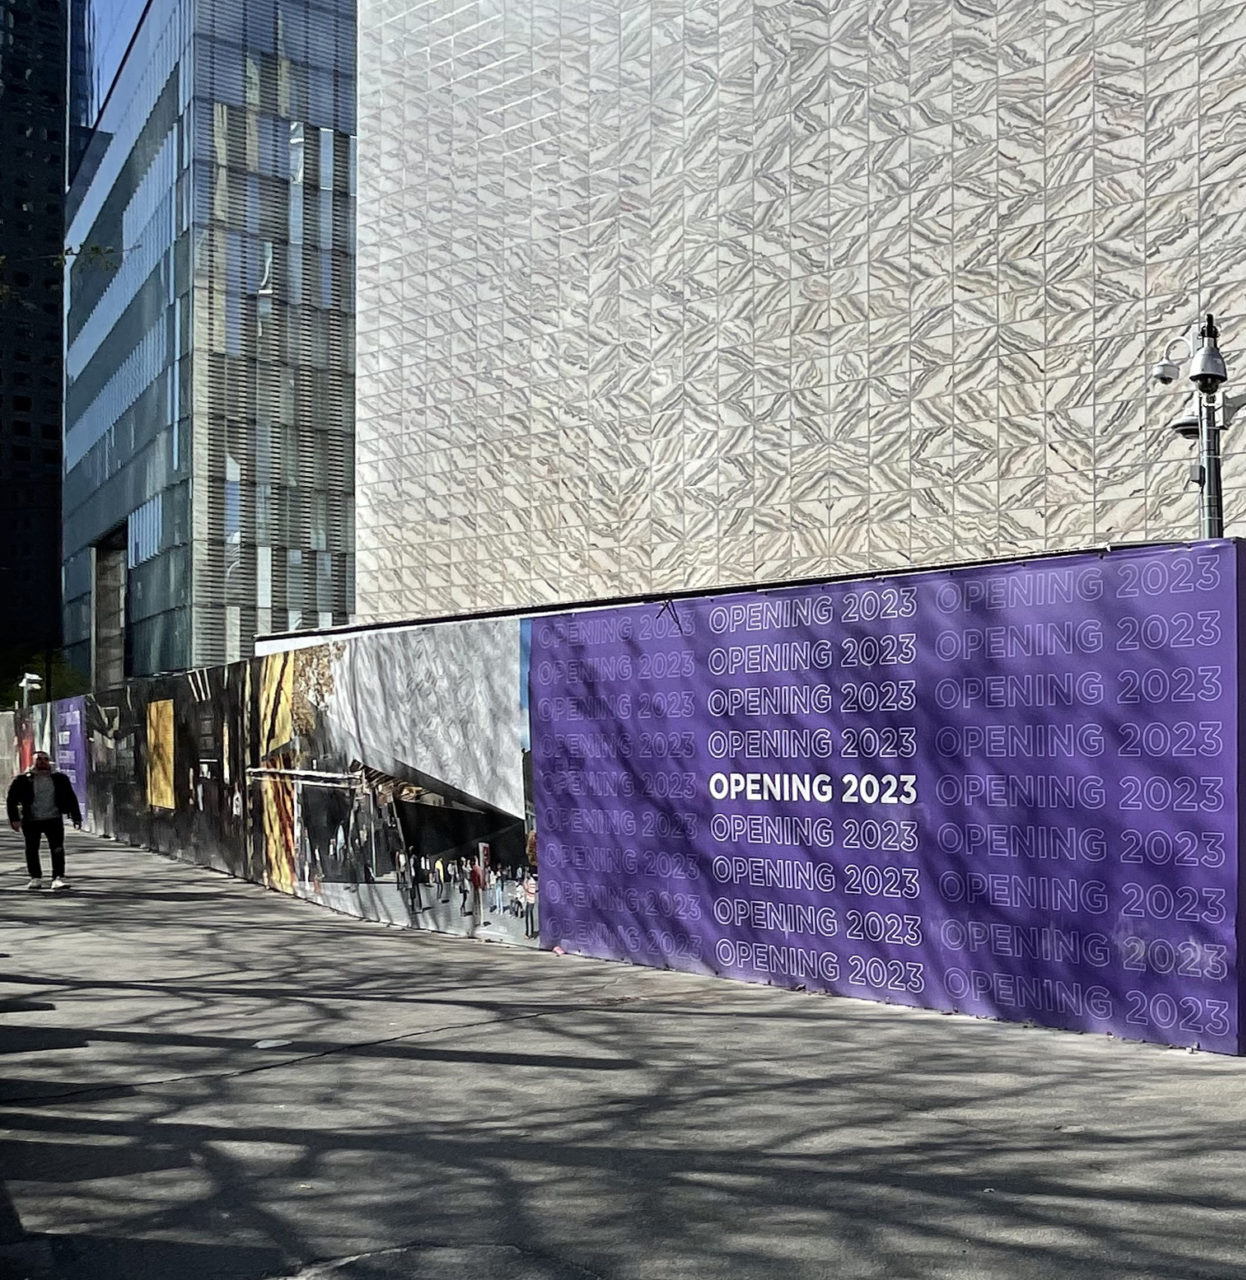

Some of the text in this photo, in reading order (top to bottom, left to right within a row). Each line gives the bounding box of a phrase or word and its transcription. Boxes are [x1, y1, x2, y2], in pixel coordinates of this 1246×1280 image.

[935, 555, 1220, 614] OPENING 2023
[538, 610, 695, 649] OPENING 2023
[709, 587, 917, 633] OPENING 2023
[708, 634, 917, 675] OPENING 2023
[935, 610, 1221, 661] OPENING 2023
[538, 650, 695, 685] OPENING 2023
[538, 691, 695, 721] OPENING 2023
[708, 680, 917, 716] OPENING 2023
[935, 666, 1222, 709] OPENING 2023
[540, 732, 695, 758] OPENING 2023
[708, 727, 917, 758] OPENING 2023
[935, 722, 1223, 757] OPENING 2023
[542, 771, 697, 799] OPENING 2023
[709, 773, 917, 804] OPENING 2023
[935, 774, 1224, 812] OPENING 2023
[544, 807, 698, 839] OPENING 2023
[710, 813, 918, 852] OPENING 2023
[545, 843, 700, 880] OPENING 2023
[937, 822, 1226, 868] OPENING 2023
[712, 855, 920, 899] OPENING 2023
[545, 880, 701, 920] OPENING 2023
[939, 871, 1227, 924] OPENING 2023
[713, 897, 922, 946] OPENING 2023
[715, 938, 924, 993] OPENING 2023
[941, 919, 1228, 980] OPENING 2023
[944, 967, 1230, 1036] OPENING 2023
